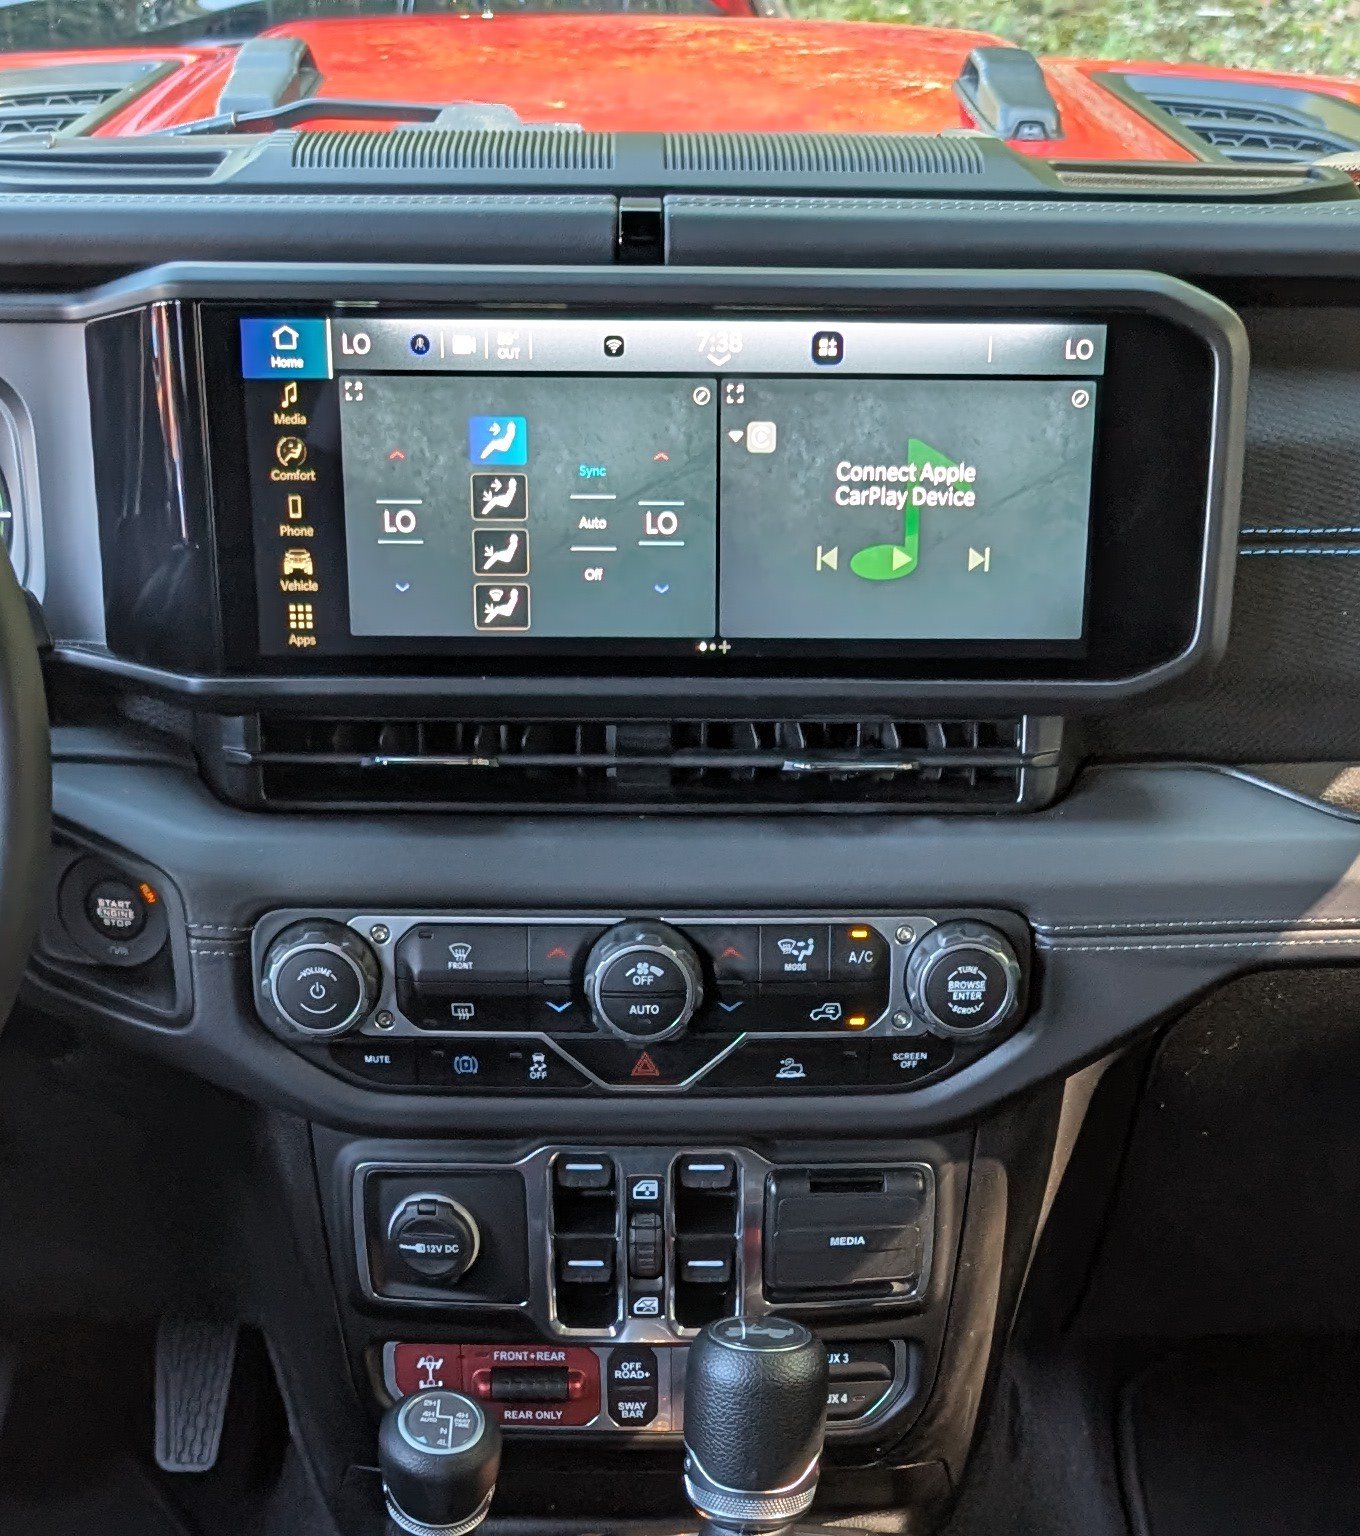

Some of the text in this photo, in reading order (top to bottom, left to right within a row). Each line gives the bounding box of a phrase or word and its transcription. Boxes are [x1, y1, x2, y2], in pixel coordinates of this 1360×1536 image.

[342, 333, 371, 354] LO
[1065, 339, 1094, 360] LO
[271, 356, 304, 370] Home
[273, 412, 307, 426] Media
[270, 468, 317, 482] Comfort
[579, 464, 607, 479] Sync
[836, 461, 977, 485] Connect Apple
[835, 486, 976, 511] CarPlay Device
[384, 509, 416, 534] LO
[578, 516, 608, 530] Auto
[646, 511, 678, 535] LO
[279, 524, 315, 538] Phone
[584, 567, 604, 582] Off
[280, 580, 319, 593] Vehicle
[288, 634, 316, 648] Apps
[97, 898, 132, 909] START
[103, 918, 132, 928] STOP
[848, 951, 874, 965] A/C
[301, 966, 333, 978] VOLUME
[447, 961, 474, 971] FRONT
[784, 962, 808, 972] MODE
[957, 966, 978, 976] TUNE
[632, 975, 654, 986] OFF
[948, 980, 986, 990] BROWSE
[952, 991, 982, 1002] ENTER
[628, 1004, 660, 1016] AUTO
[950, 1004, 982, 1016] SCROLL
[364, 1054, 391, 1064] MUTE
[892, 1052, 928, 1062] SCREEN
[900, 1060, 918, 1070] OFF
[529, 1072, 548, 1080] OFF
[830, 1236, 865, 1246] MEDIA
[444, 1244, 460, 1254] DC
[621, 1362, 642, 1371] OFF
[618, 1402, 647, 1411] SWAY
[504, 1410, 563, 1420] REAR ONLY
[622, 1410, 644, 1420] BAR
